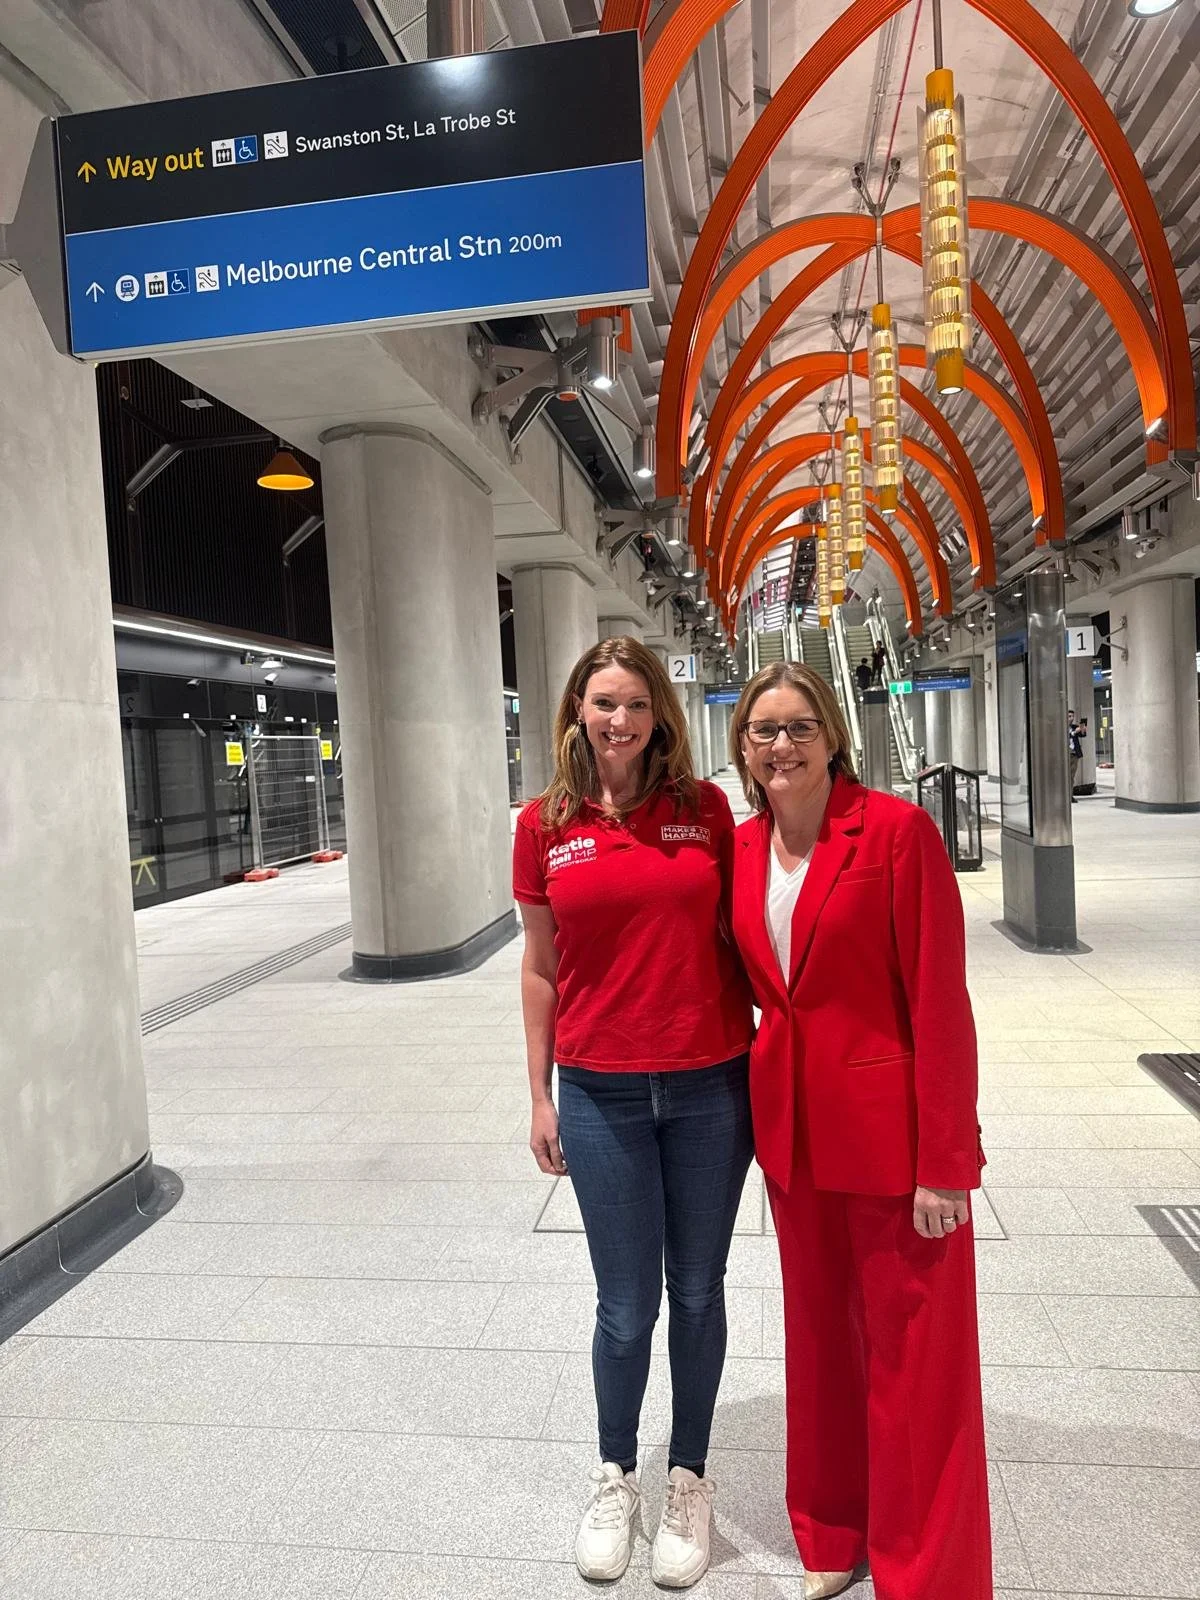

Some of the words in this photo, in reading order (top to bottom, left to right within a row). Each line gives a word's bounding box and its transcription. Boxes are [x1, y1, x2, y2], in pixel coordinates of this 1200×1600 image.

[295, 127, 381, 153] Swanston
[385, 124, 410, 141] St,
[413, 120, 436, 138] La
[440, 113, 491, 133] Trobe
[495, 108, 516, 126] St
[106, 155, 158, 181] Way
[164, 147, 205, 172] out
[226, 255, 353, 287] Melbourne
[359, 238, 452, 271] Central
[458, 234, 502, 259] Stn
[508, 233, 562, 254] 200m
[1076, 632, 1087, 651] 1
[673, 659, 686, 677] 2
[548, 836, 596, 859] Katie
[549, 852, 572, 869] Hall
[574, 847, 597, 860] MP
